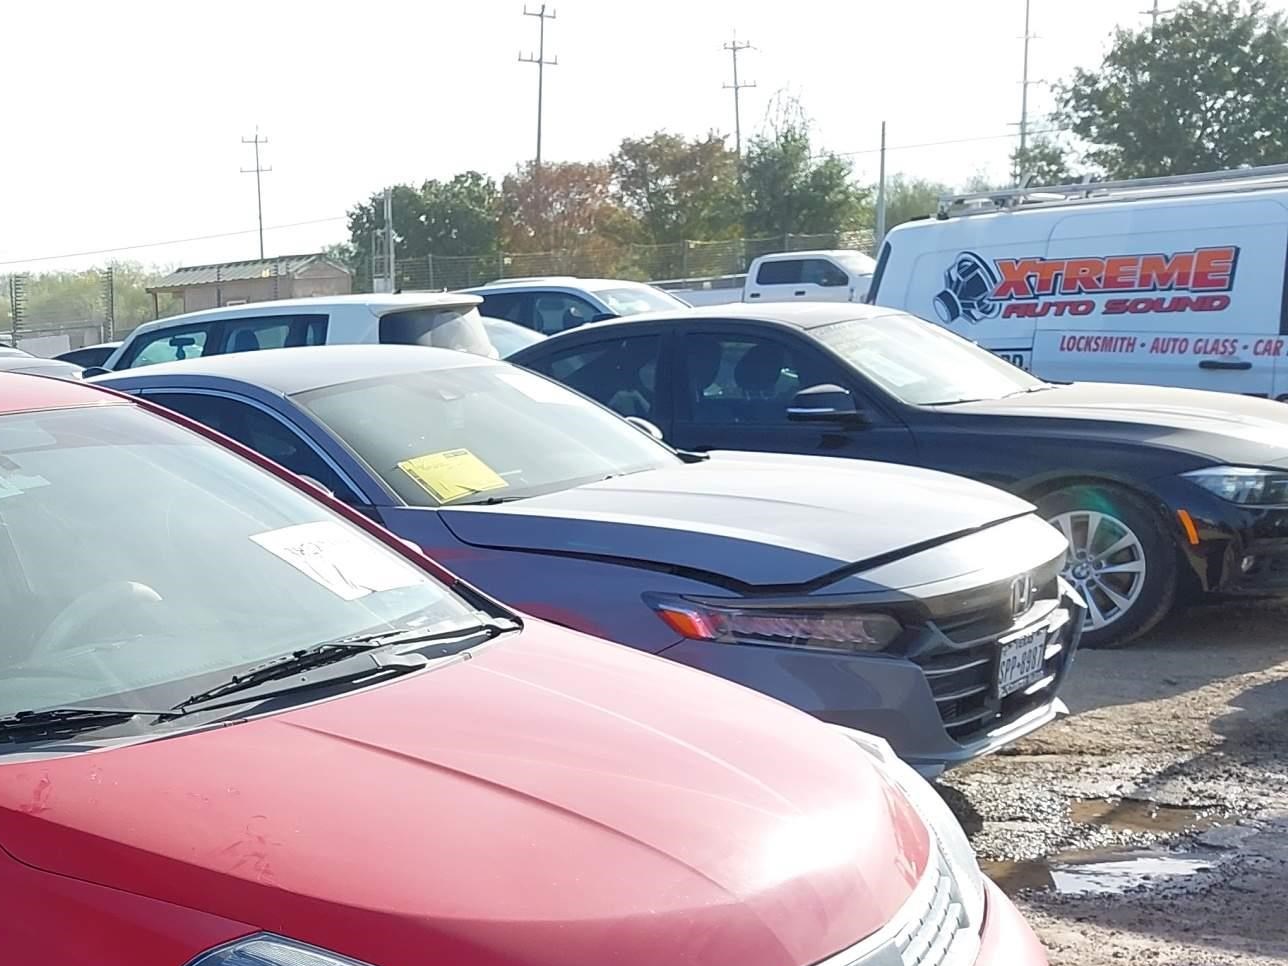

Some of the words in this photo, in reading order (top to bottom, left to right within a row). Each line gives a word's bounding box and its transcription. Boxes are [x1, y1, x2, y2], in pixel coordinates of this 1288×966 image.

[992, 247, 1240, 299] XTREME
[1002, 300, 1096, 319] AUTO
[1101, 295, 1231, 315] SOUND
[1059, 335, 1138, 353] LOCKSMITH
[1149, 337, 1189, 354] AUTO
[1192, 338, 1239, 355] GLASS
[1252, 339, 1285, 356] CAR
